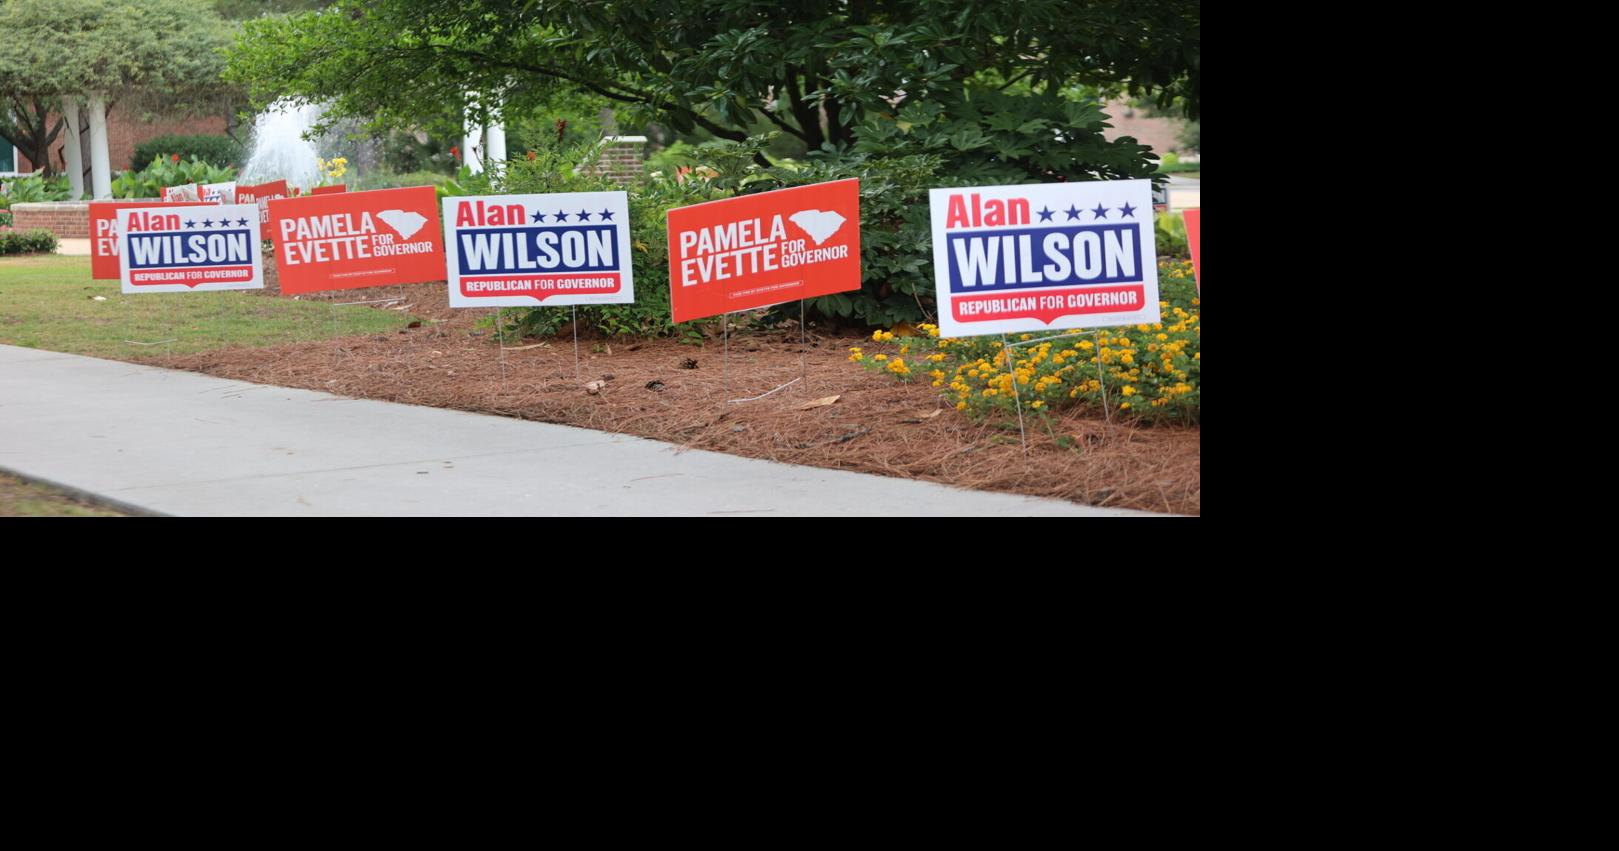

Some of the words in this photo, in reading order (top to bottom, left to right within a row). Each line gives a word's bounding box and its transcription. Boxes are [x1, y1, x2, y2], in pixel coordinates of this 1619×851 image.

[127, 211, 180, 232] Alan
[456, 200, 526, 227] Alan
[946, 193, 1031, 229] Alan
[280, 211, 376, 241] PAMELA
[371, 233, 394, 246] FOR
[680, 214, 787, 259] PAMELA
[130, 233, 248, 266] WILSON
[283, 235, 372, 265] EVETTE
[373, 241, 433, 257] GOVERNOR
[461, 229, 614, 271] WILSON
[781, 238, 806, 255] FOR
[781, 244, 848, 268] GOVERNOR
[952, 229, 1136, 288] WILSON
[134, 271, 185, 282] REPUBLICAN
[186, 271, 203, 280] FOR
[204, 270, 249, 280] GOVERNOR
[681, 243, 779, 288] EVETTE
[466, 280, 532, 292] REPUBLICAN
[534, 279, 554, 290] FOR
[557, 277, 615, 290] GOVERNOR
[959, 295, 1037, 316] REPUBLICAN
[1039, 294, 1064, 310] FOR
[1067, 290, 1138, 309] GOVERNOR
